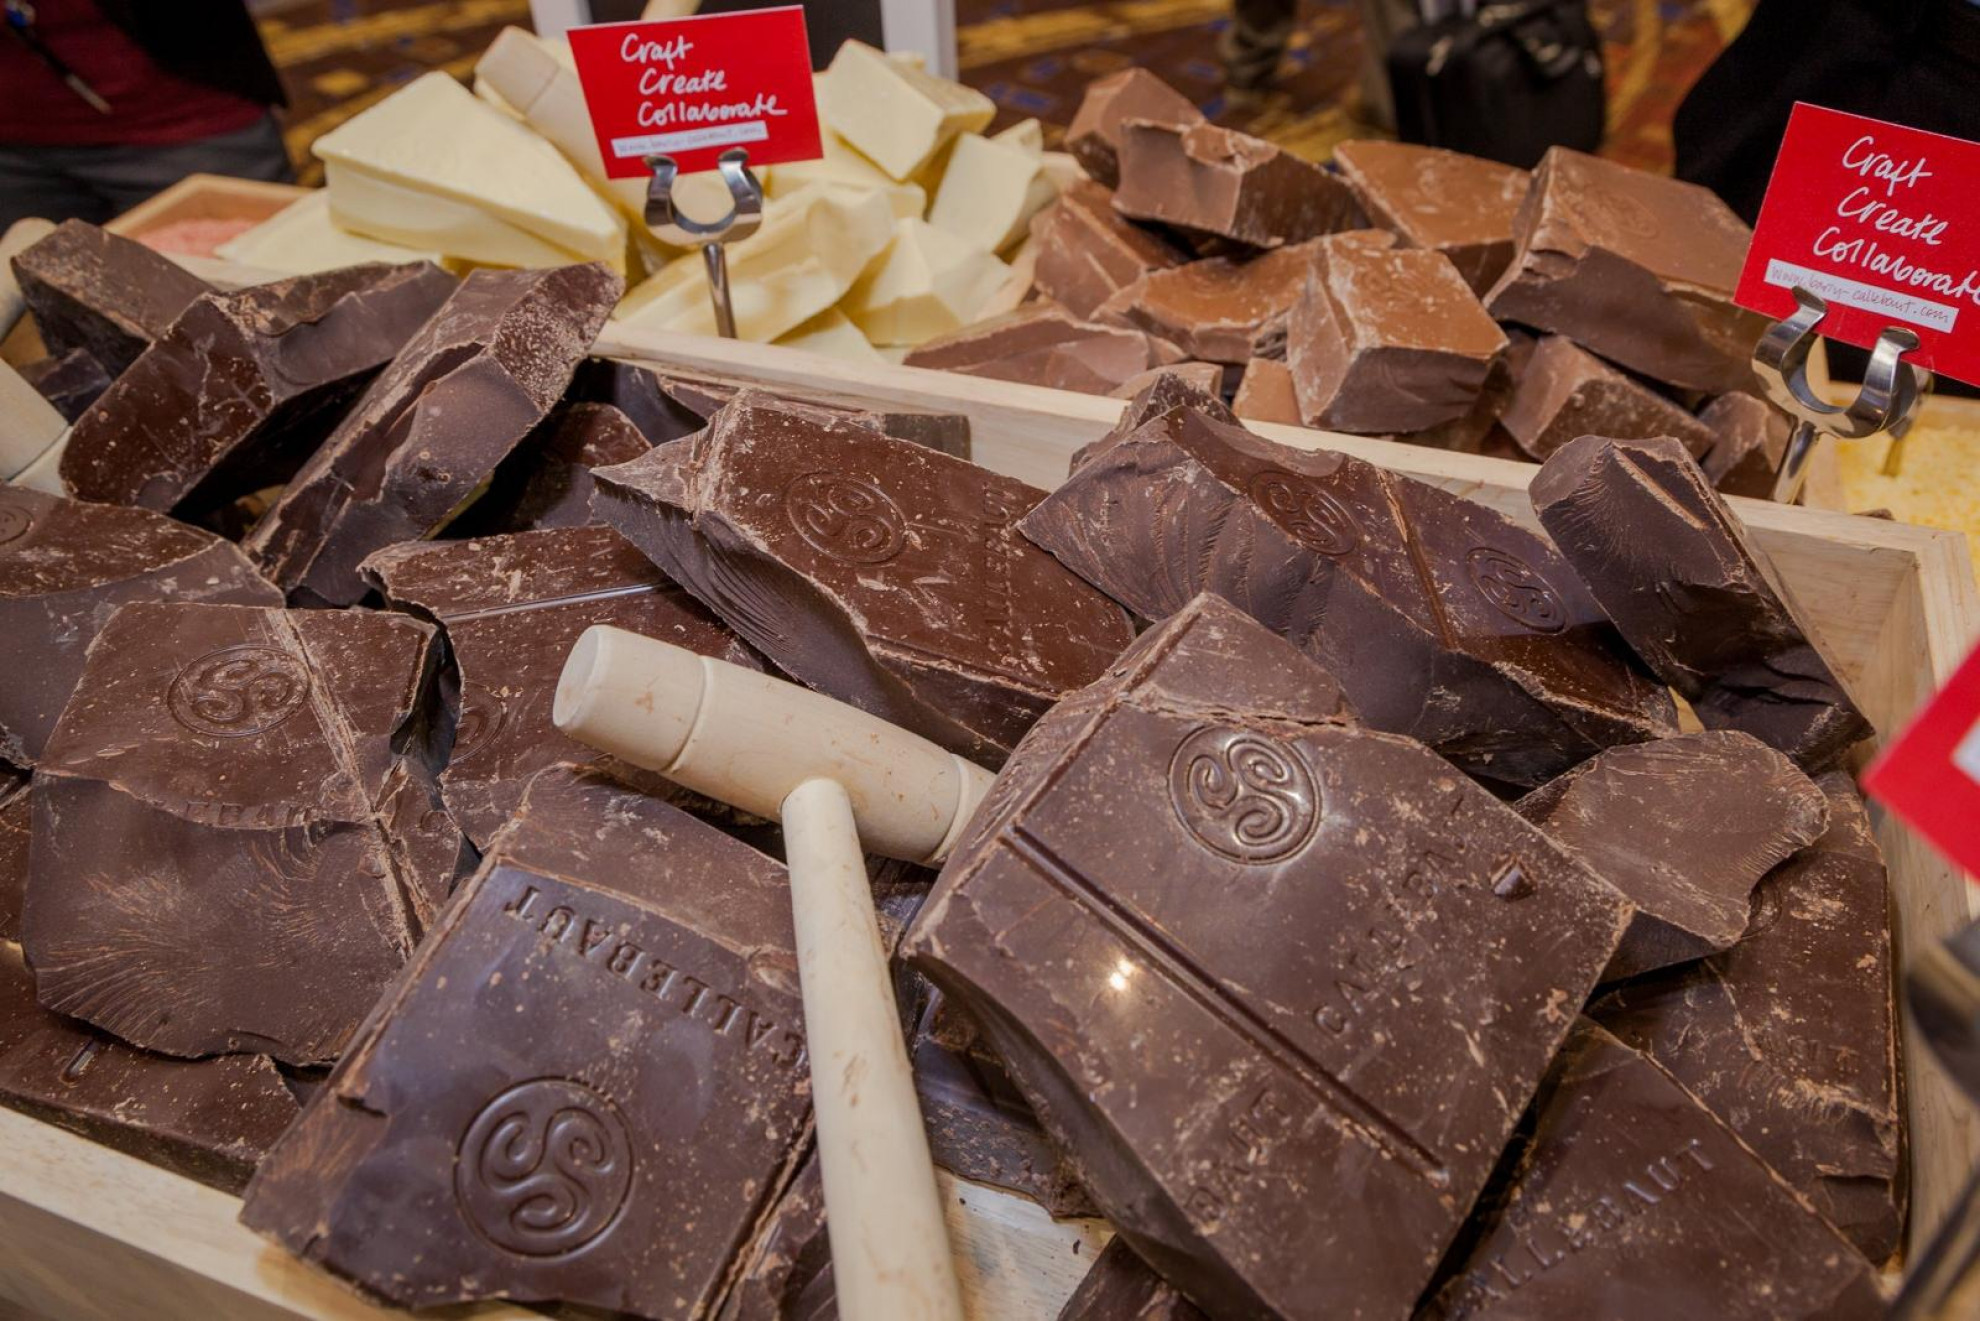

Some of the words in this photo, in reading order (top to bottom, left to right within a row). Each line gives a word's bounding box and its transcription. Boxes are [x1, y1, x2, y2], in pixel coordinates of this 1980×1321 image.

[620, 33, 693, 69] Craft
[638, 67, 727, 95] Create
[637, 92, 787, 127] Collaborate
[1842, 135, 1932, 196] Craft
[1837, 187, 1948, 245] Create
[504, 885, 806, 1069] CALLEBAUT
